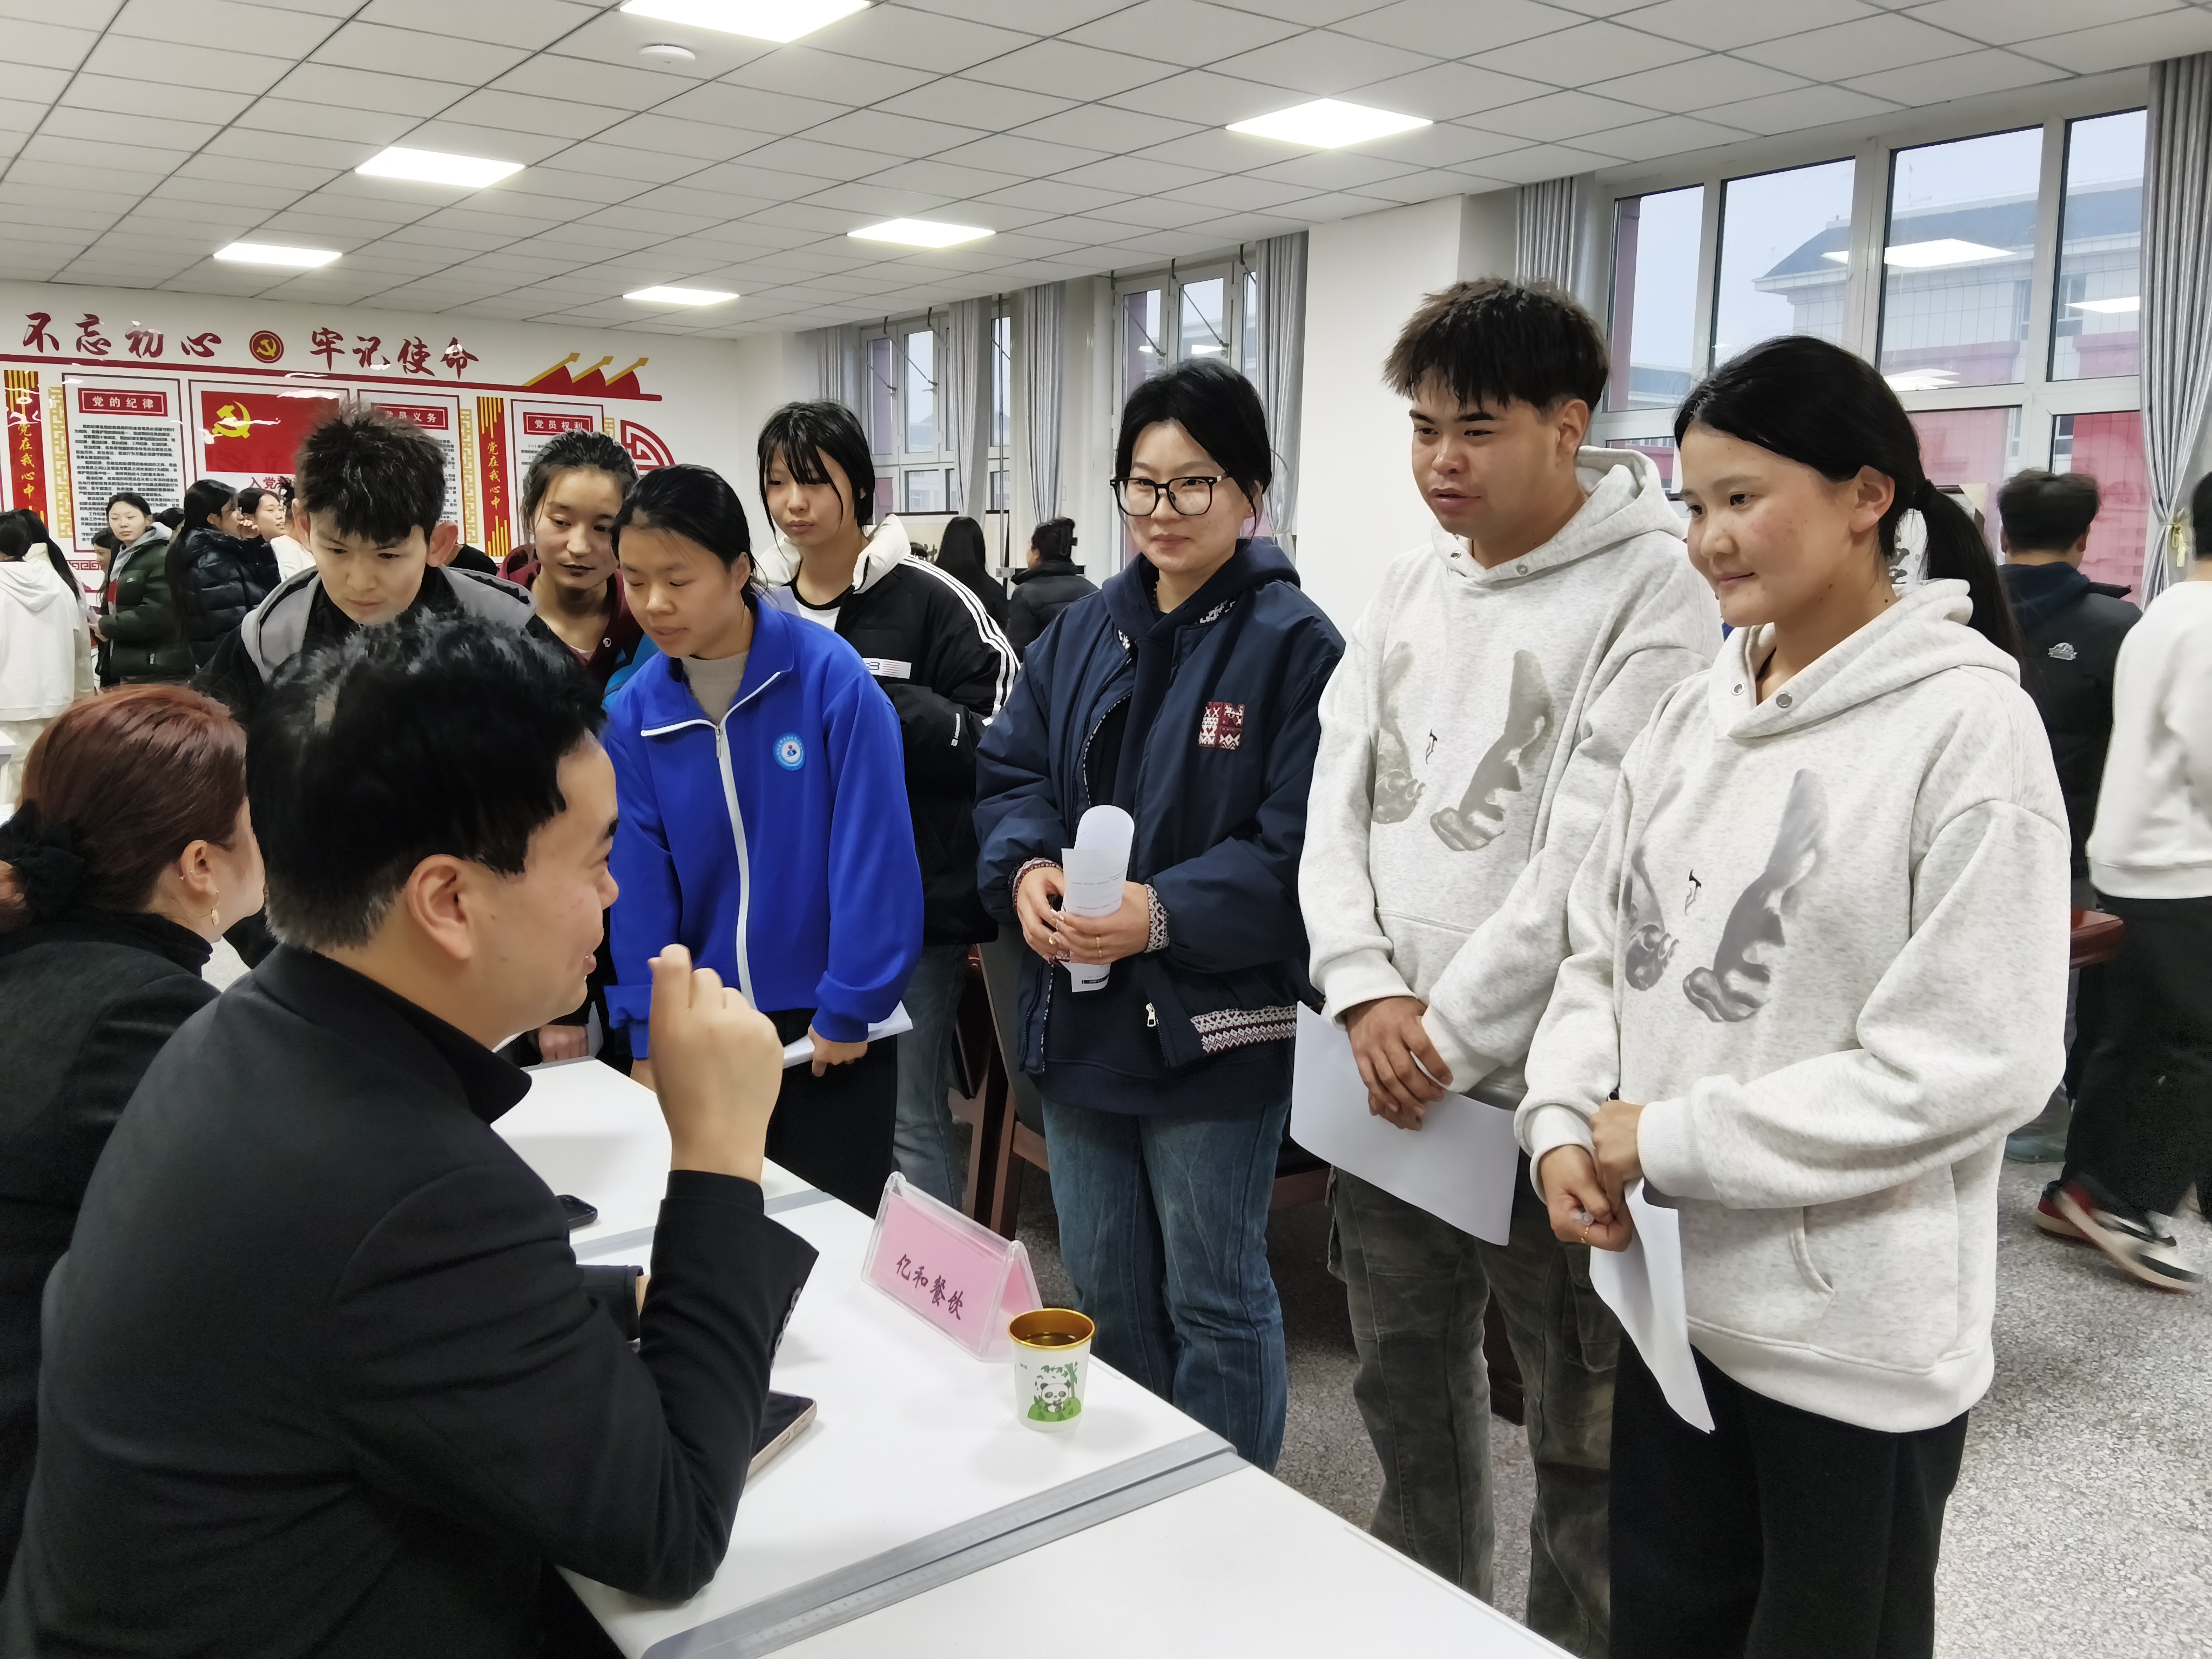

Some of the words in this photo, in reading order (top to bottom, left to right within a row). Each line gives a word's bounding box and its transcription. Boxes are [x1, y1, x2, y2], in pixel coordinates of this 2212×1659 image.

[23, 312, 222, 359] 不忘初心
[309, 327, 479, 380] 牢记使命
[92, 395, 154, 409] 党的纪律
[535, 419, 583, 430] 党员权利
[18, 423, 35, 500] 党在我心中
[487, 441, 501, 510] 党在我心中
[896, 1253, 963, 1320] 亿和餐饮
